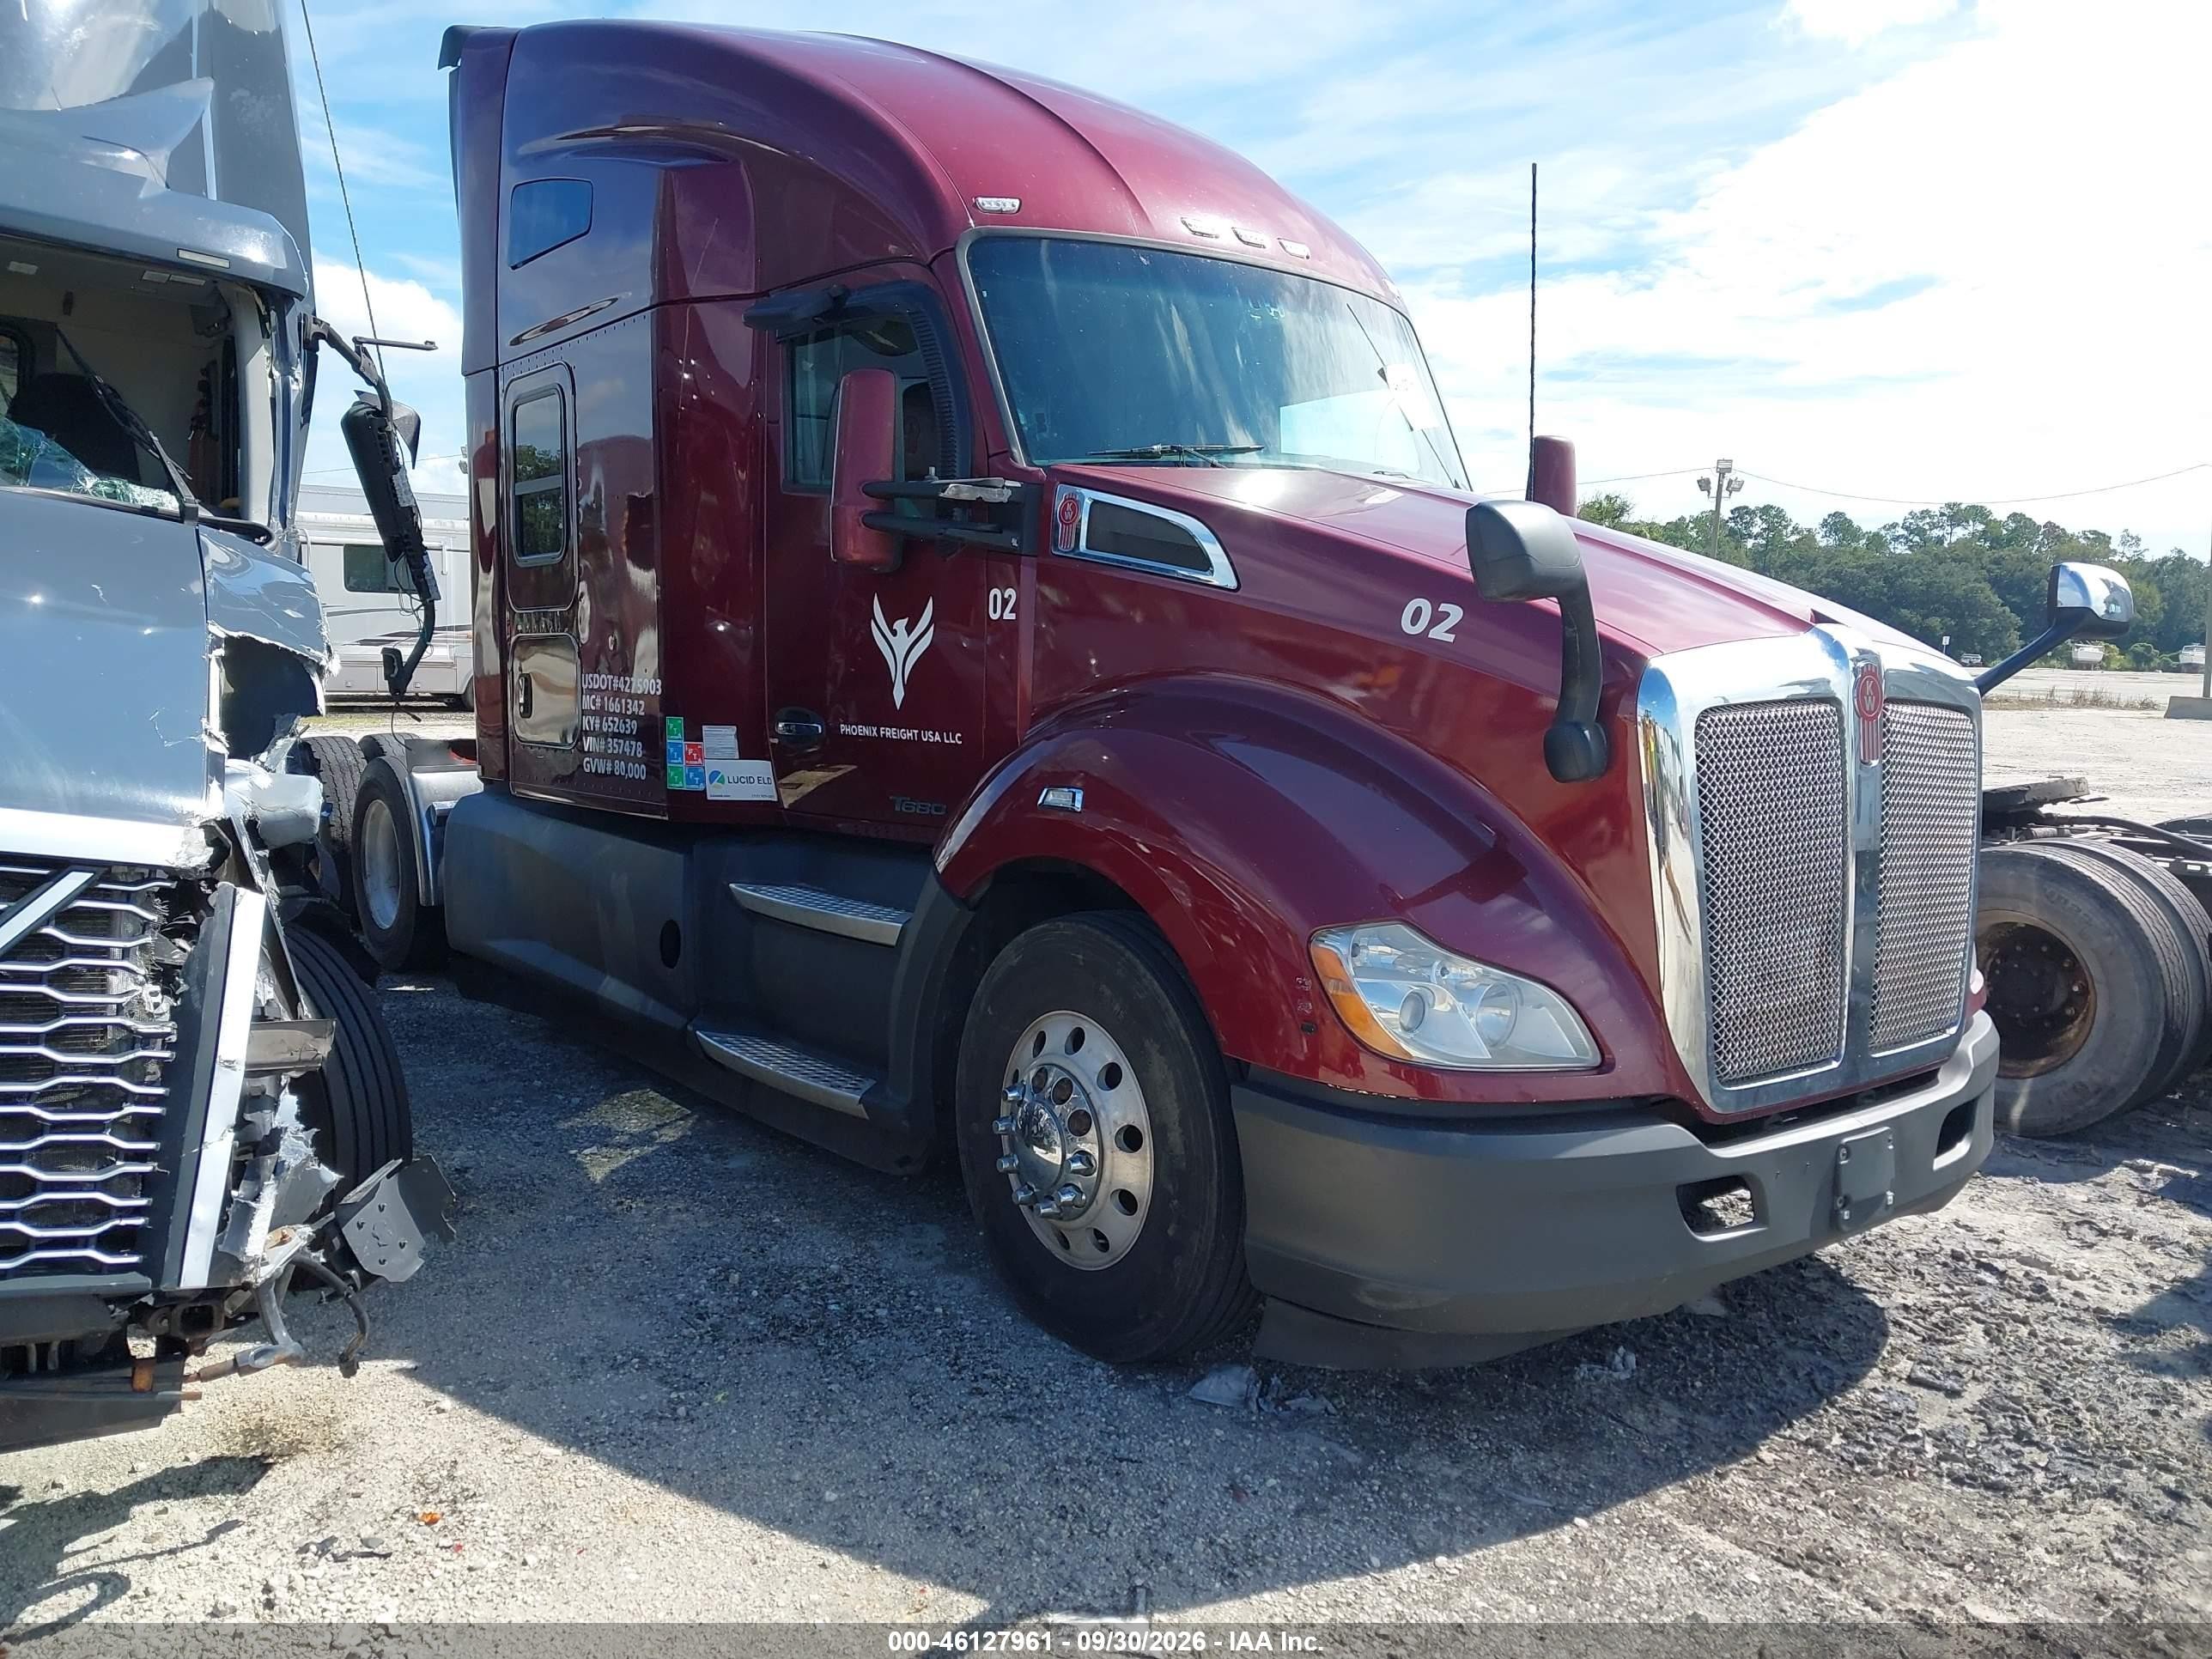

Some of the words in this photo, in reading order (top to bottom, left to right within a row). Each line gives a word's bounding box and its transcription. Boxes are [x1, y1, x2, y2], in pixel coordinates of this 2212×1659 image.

[988, 587, 1017, 620] 02
[1401, 598, 1464, 643] 02
[581, 673, 662, 696] USDOT#4275903
[582, 694, 601, 711] MC#
[604, 696, 645, 716] 1661342
[582, 715, 599, 731] KY#
[602, 717, 637, 735] 652639
[840, 724, 878, 737] PHOENIX
[879, 726, 919, 741] FREIGHT
[921, 730, 941, 743] USA
[944, 732, 963, 744] LLC
[582, 736, 605, 753] VIN#
[607, 738, 642, 757] 357478
[583, 757, 612, 775] GVW#
[614, 759, 647, 781] 80,000
[727, 775, 755, 784] LUCID
[757, 775, 772, 785] ELD
[889, 795, 947, 816] T680
